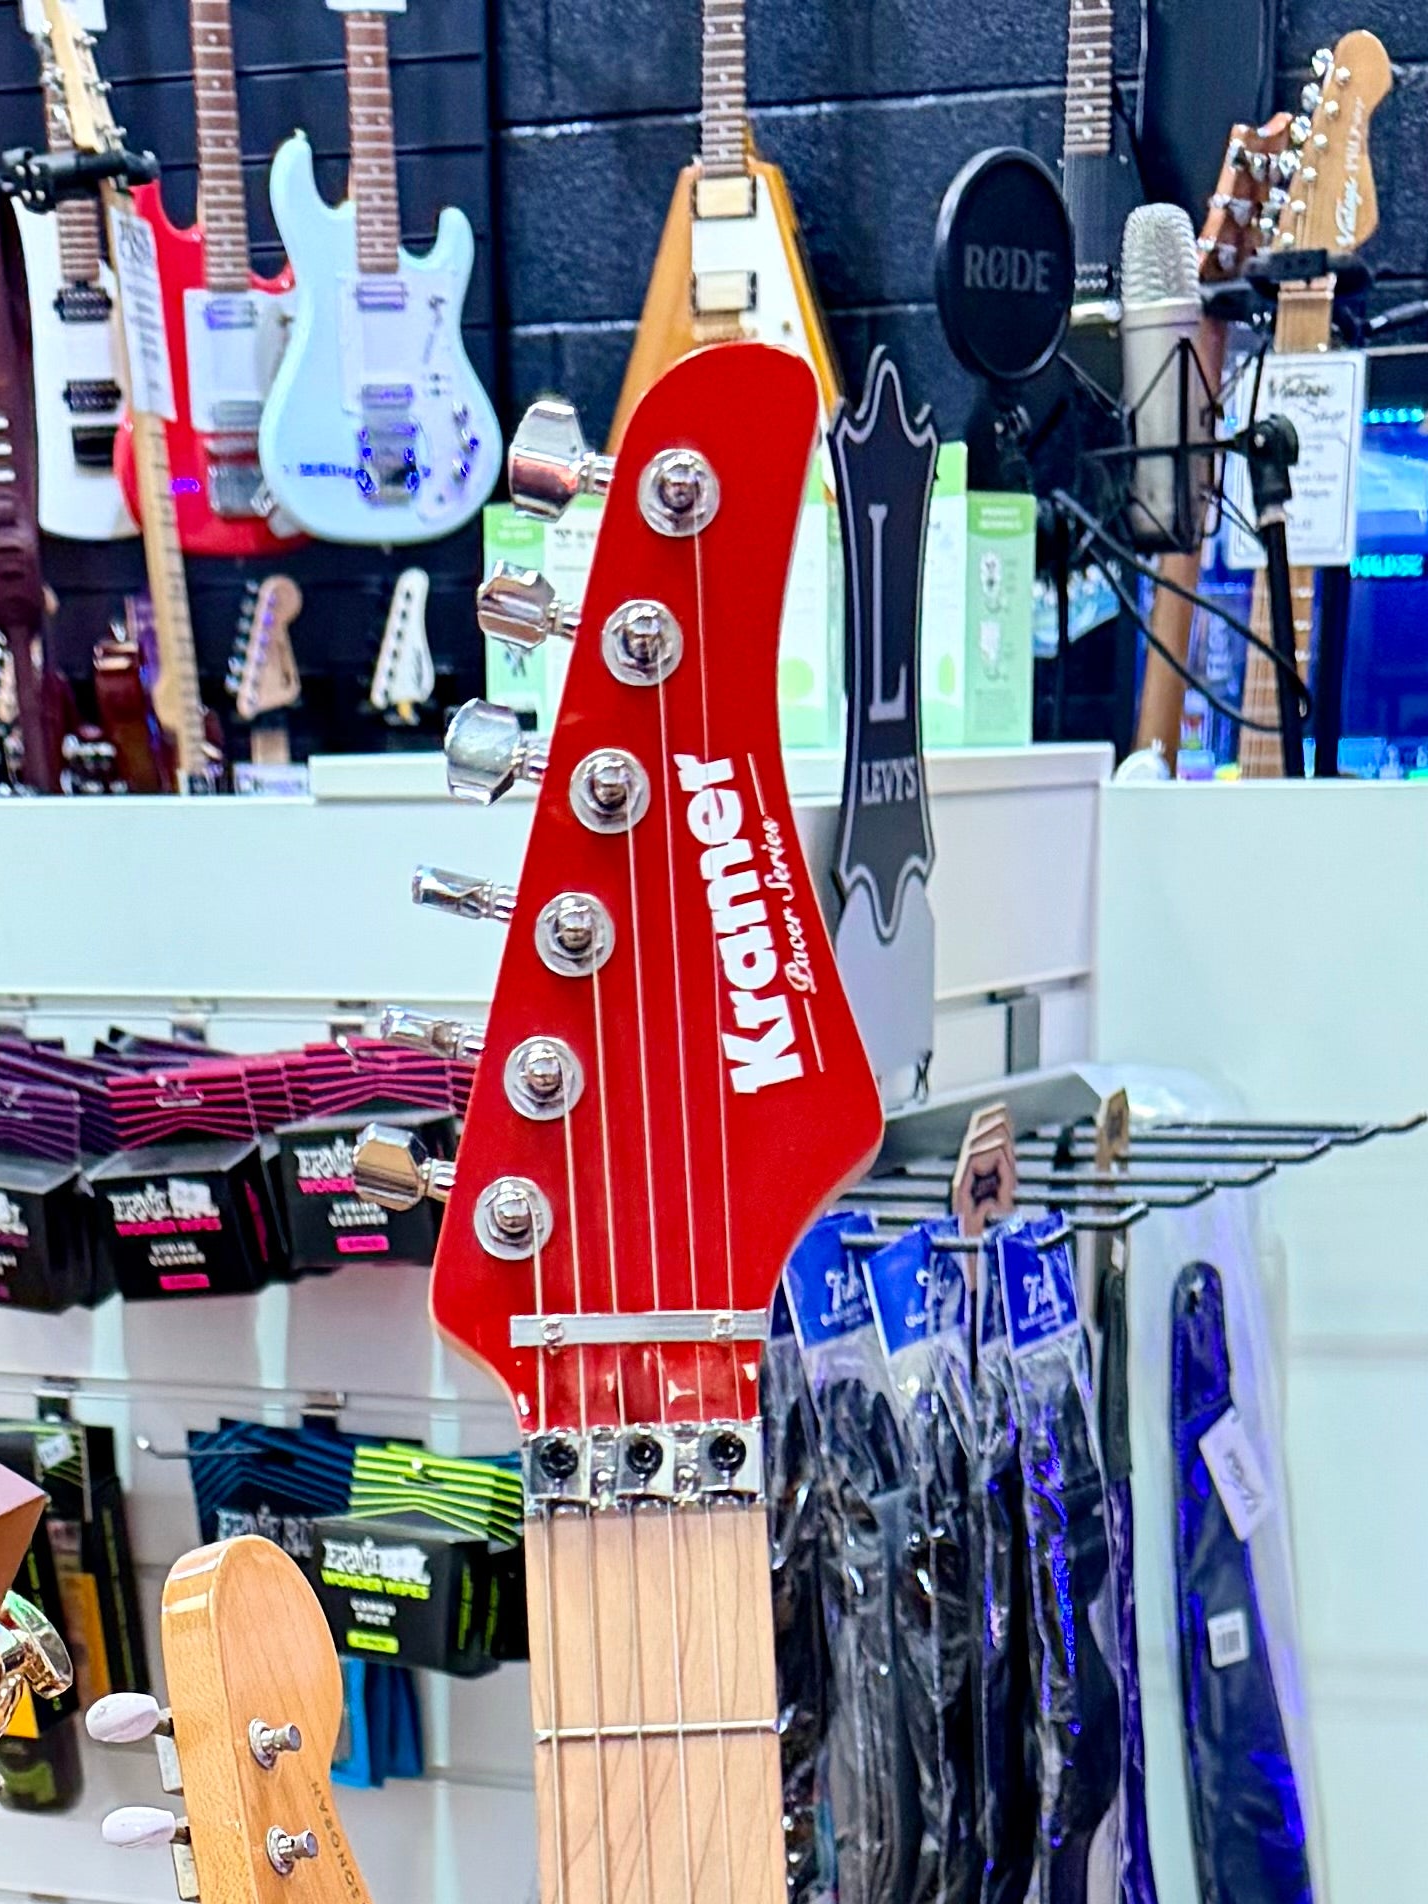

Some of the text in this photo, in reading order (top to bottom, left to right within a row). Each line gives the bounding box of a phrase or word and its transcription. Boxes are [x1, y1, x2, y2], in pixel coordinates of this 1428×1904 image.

[963, 243, 1056, 296] RØDE
[868, 503, 908, 724] L
[673, 752, 806, 1095] Kramer
[762, 815, 818, 996] Pacer Series
[309, 1780, 362, 1900] SONORAN
